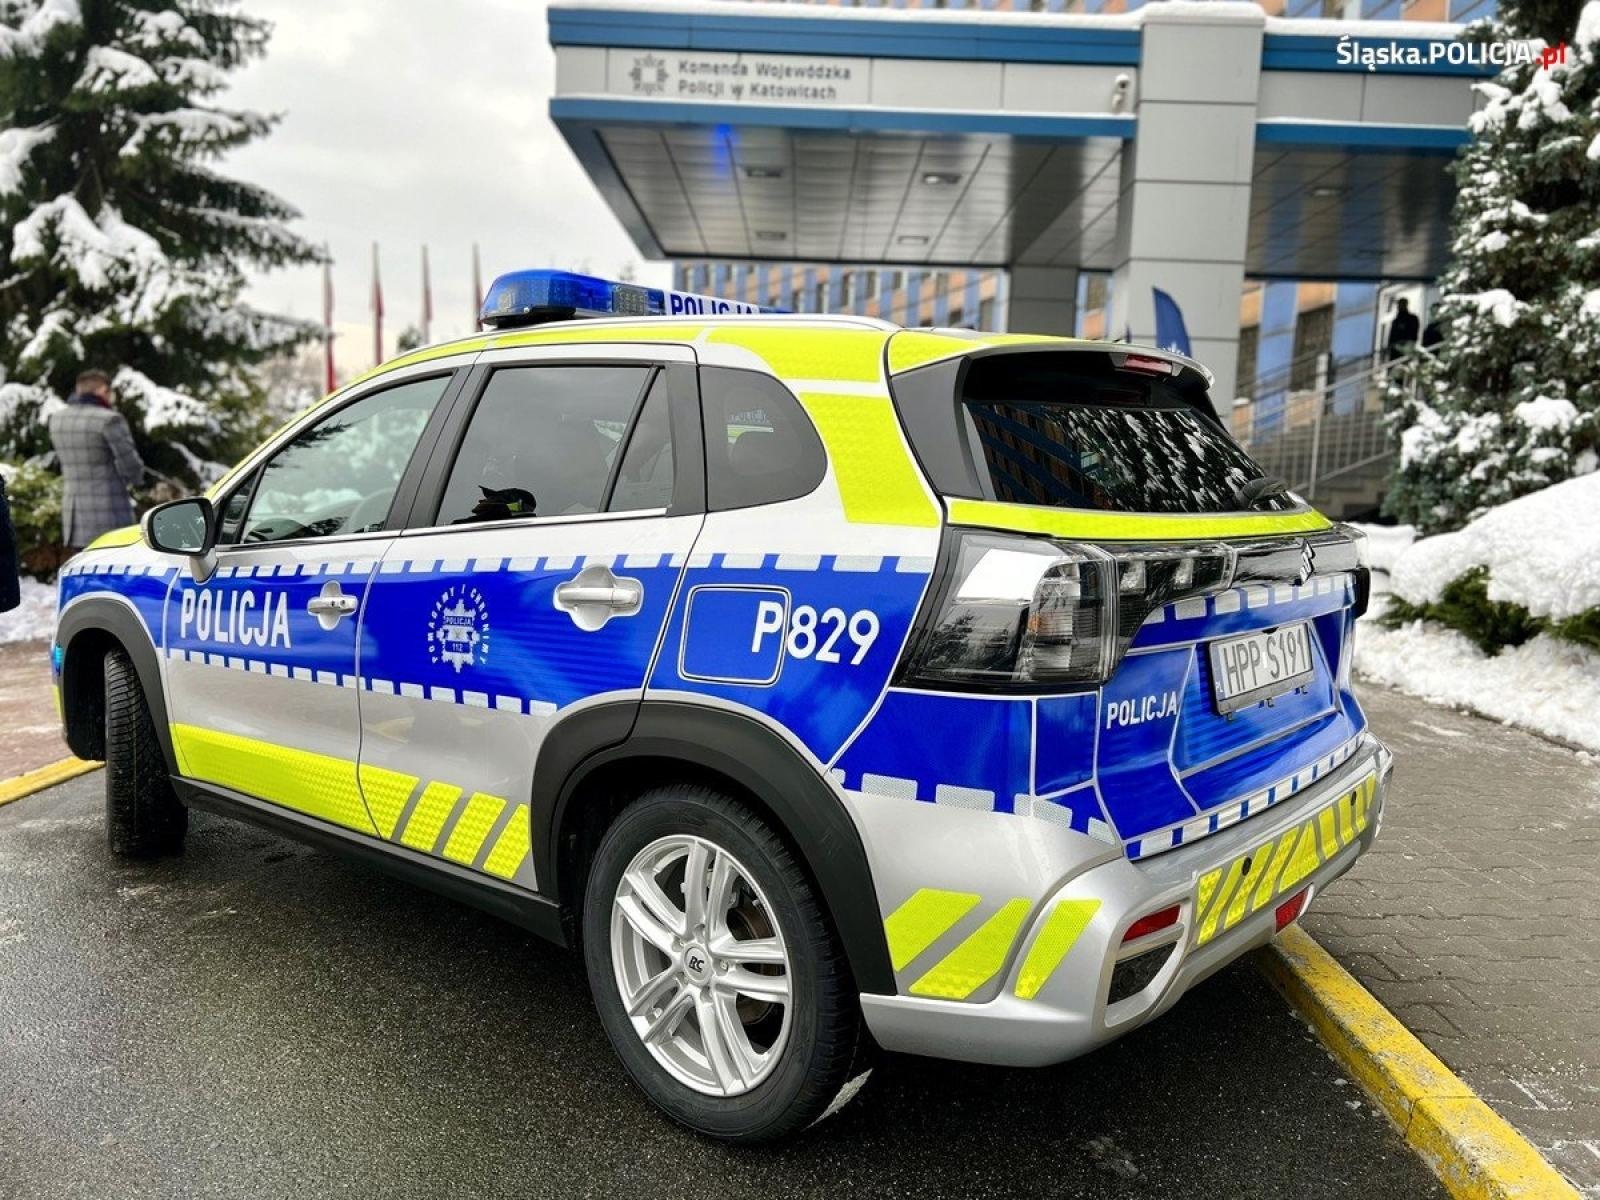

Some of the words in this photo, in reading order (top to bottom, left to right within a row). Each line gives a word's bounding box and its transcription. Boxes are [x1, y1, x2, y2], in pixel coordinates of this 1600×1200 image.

[678, 60, 748, 76] Komenda
[755, 63, 851, 80] Wojewódzka
[678, 80, 725, 97] Policji
[731, 85, 744, 95] w
[751, 83, 836, 99] Katowicach
[180, 588, 291, 649] POLICJA
[751, 600, 880, 665] P829
[1223, 640, 1260, 695] HPP
[1266, 628, 1306, 679] S191
[1106, 691, 1177, 729] POLICJA
